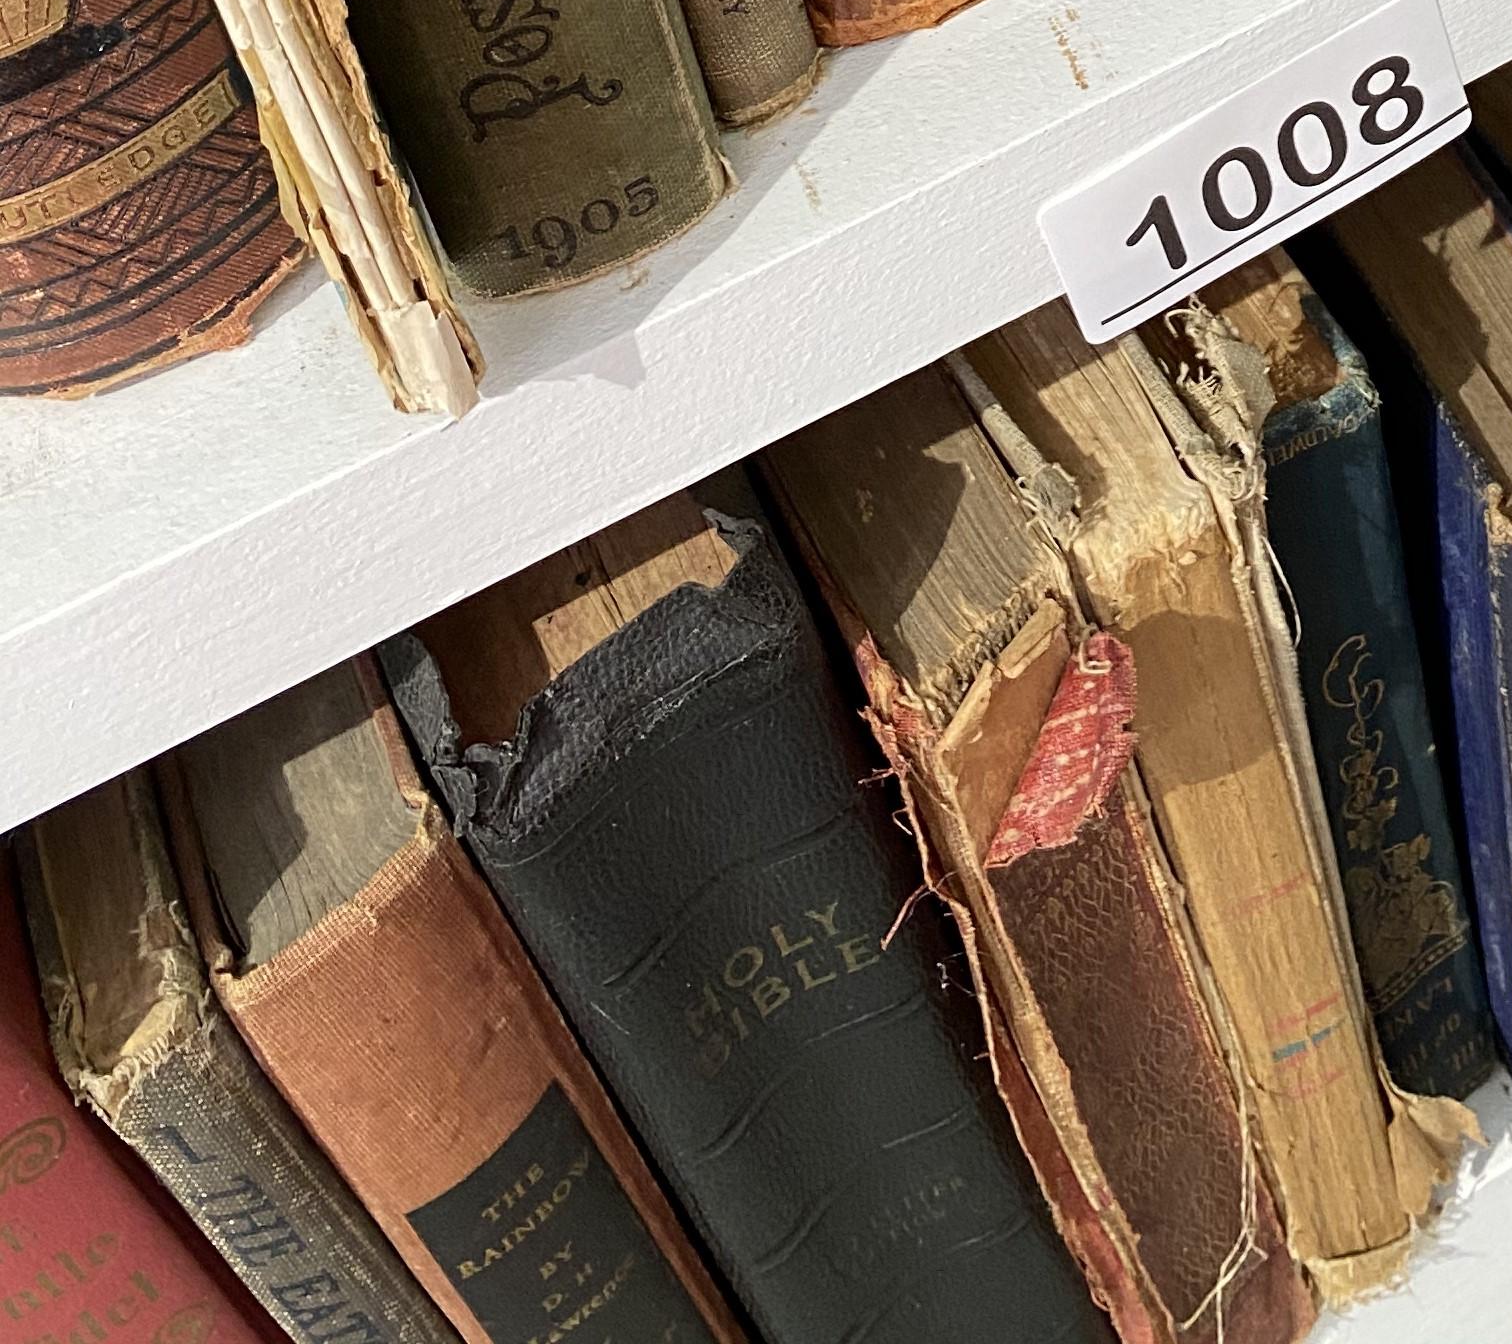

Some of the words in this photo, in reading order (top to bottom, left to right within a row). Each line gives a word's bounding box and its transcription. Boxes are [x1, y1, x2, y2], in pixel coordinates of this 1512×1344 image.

[1126, 55, 1425, 271] 1008
[496, 174, 662, 271] 1905
[687, 900, 841, 1038] HOLY
[702, 934, 882, 1080] BIBLE
[190, 1174, 308, 1268] THE
[456, 1146, 591, 1281] RAINBOW
[481, 1162, 545, 1224] THE
[539, 1239, 573, 1280] BY
